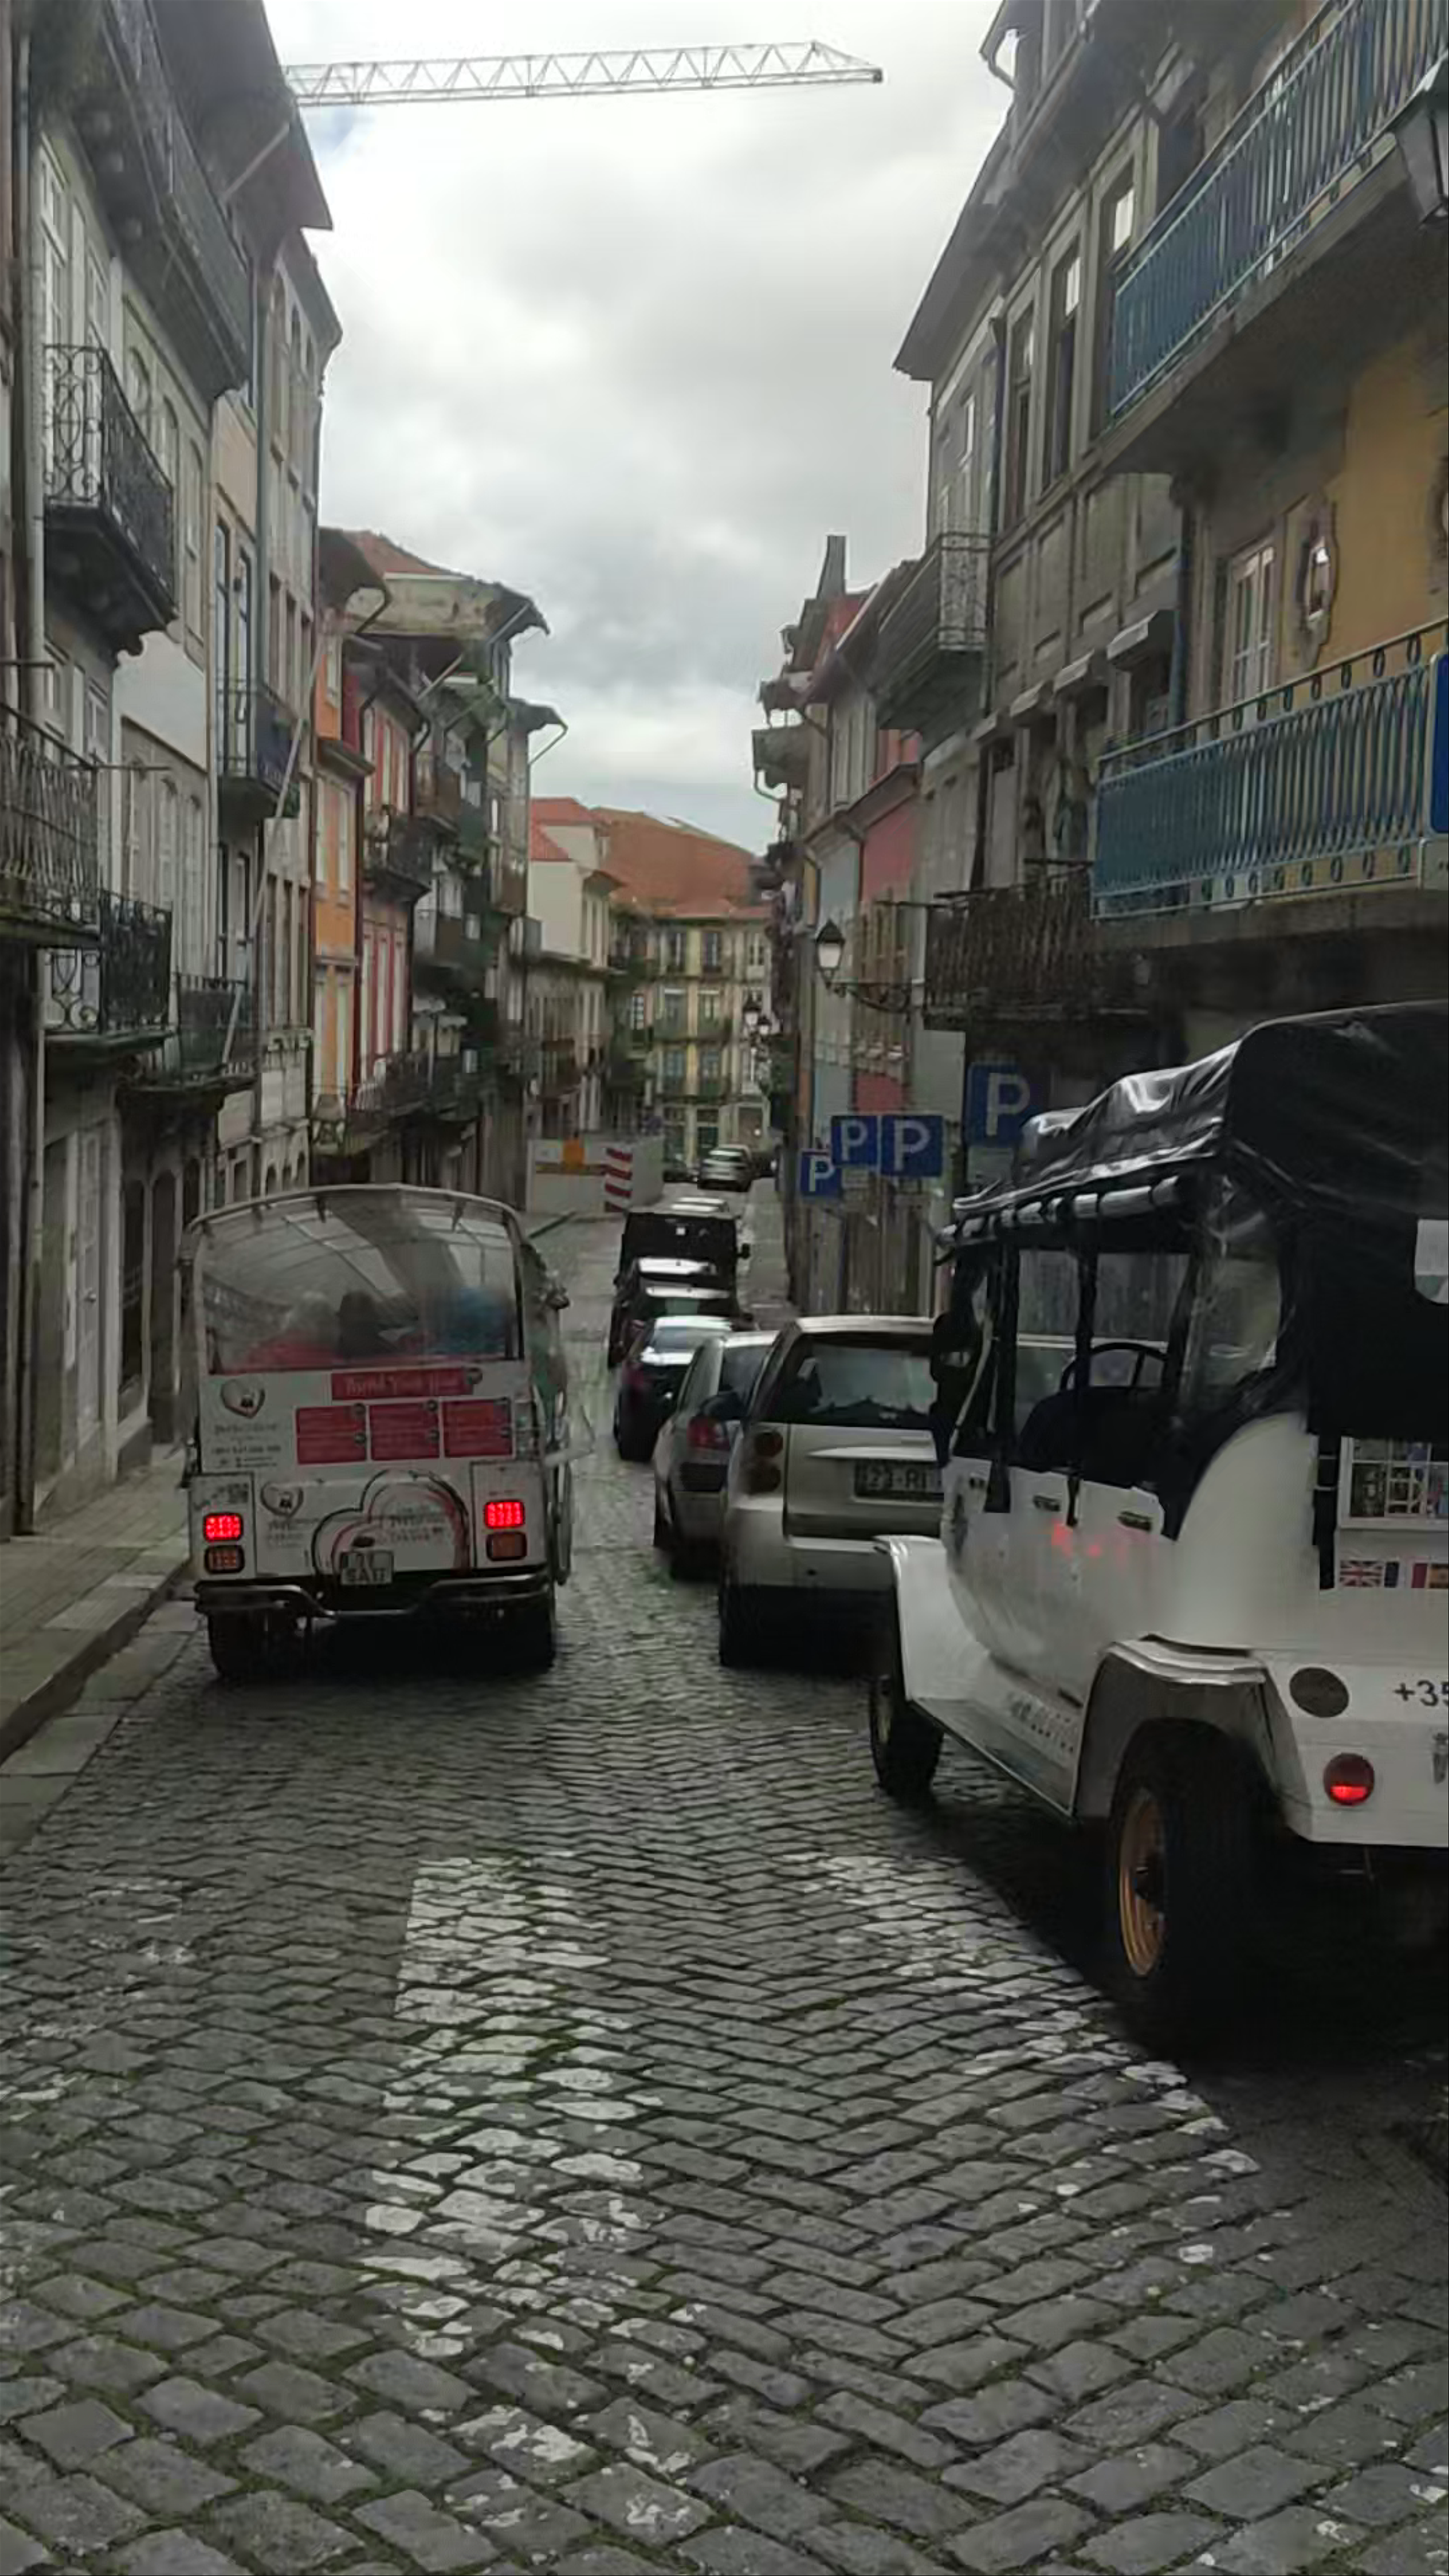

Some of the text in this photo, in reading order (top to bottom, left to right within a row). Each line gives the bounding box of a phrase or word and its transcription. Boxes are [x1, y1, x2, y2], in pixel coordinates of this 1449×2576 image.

[985, 1072, 1030, 1136] P
[841, 1120, 868, 1161] P
[894, 1120, 931, 1171] P
[809, 1157, 835, 1192] P
